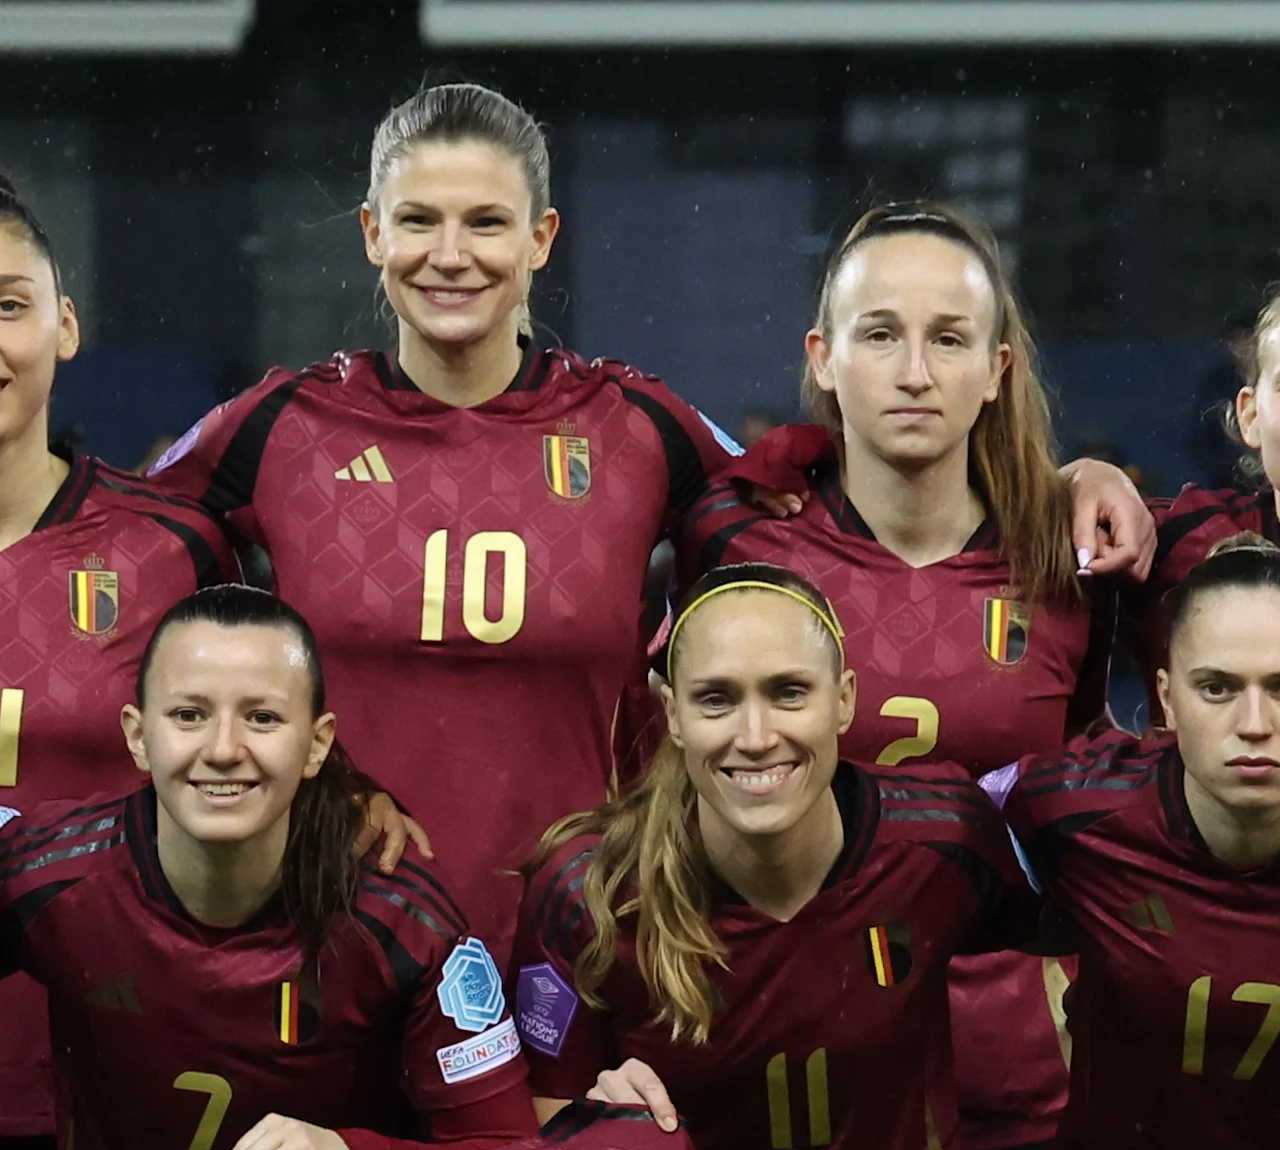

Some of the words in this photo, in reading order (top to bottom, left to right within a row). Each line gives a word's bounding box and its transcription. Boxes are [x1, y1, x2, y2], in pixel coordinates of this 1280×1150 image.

[421, 529, 526, 643] 10
[520, 1011, 559, 1038] NATIONS
[520, 1020, 555, 1045] LEAGUE
[440, 1046, 465, 1059] UEFA
[765, 1047, 831, 1149] 11
